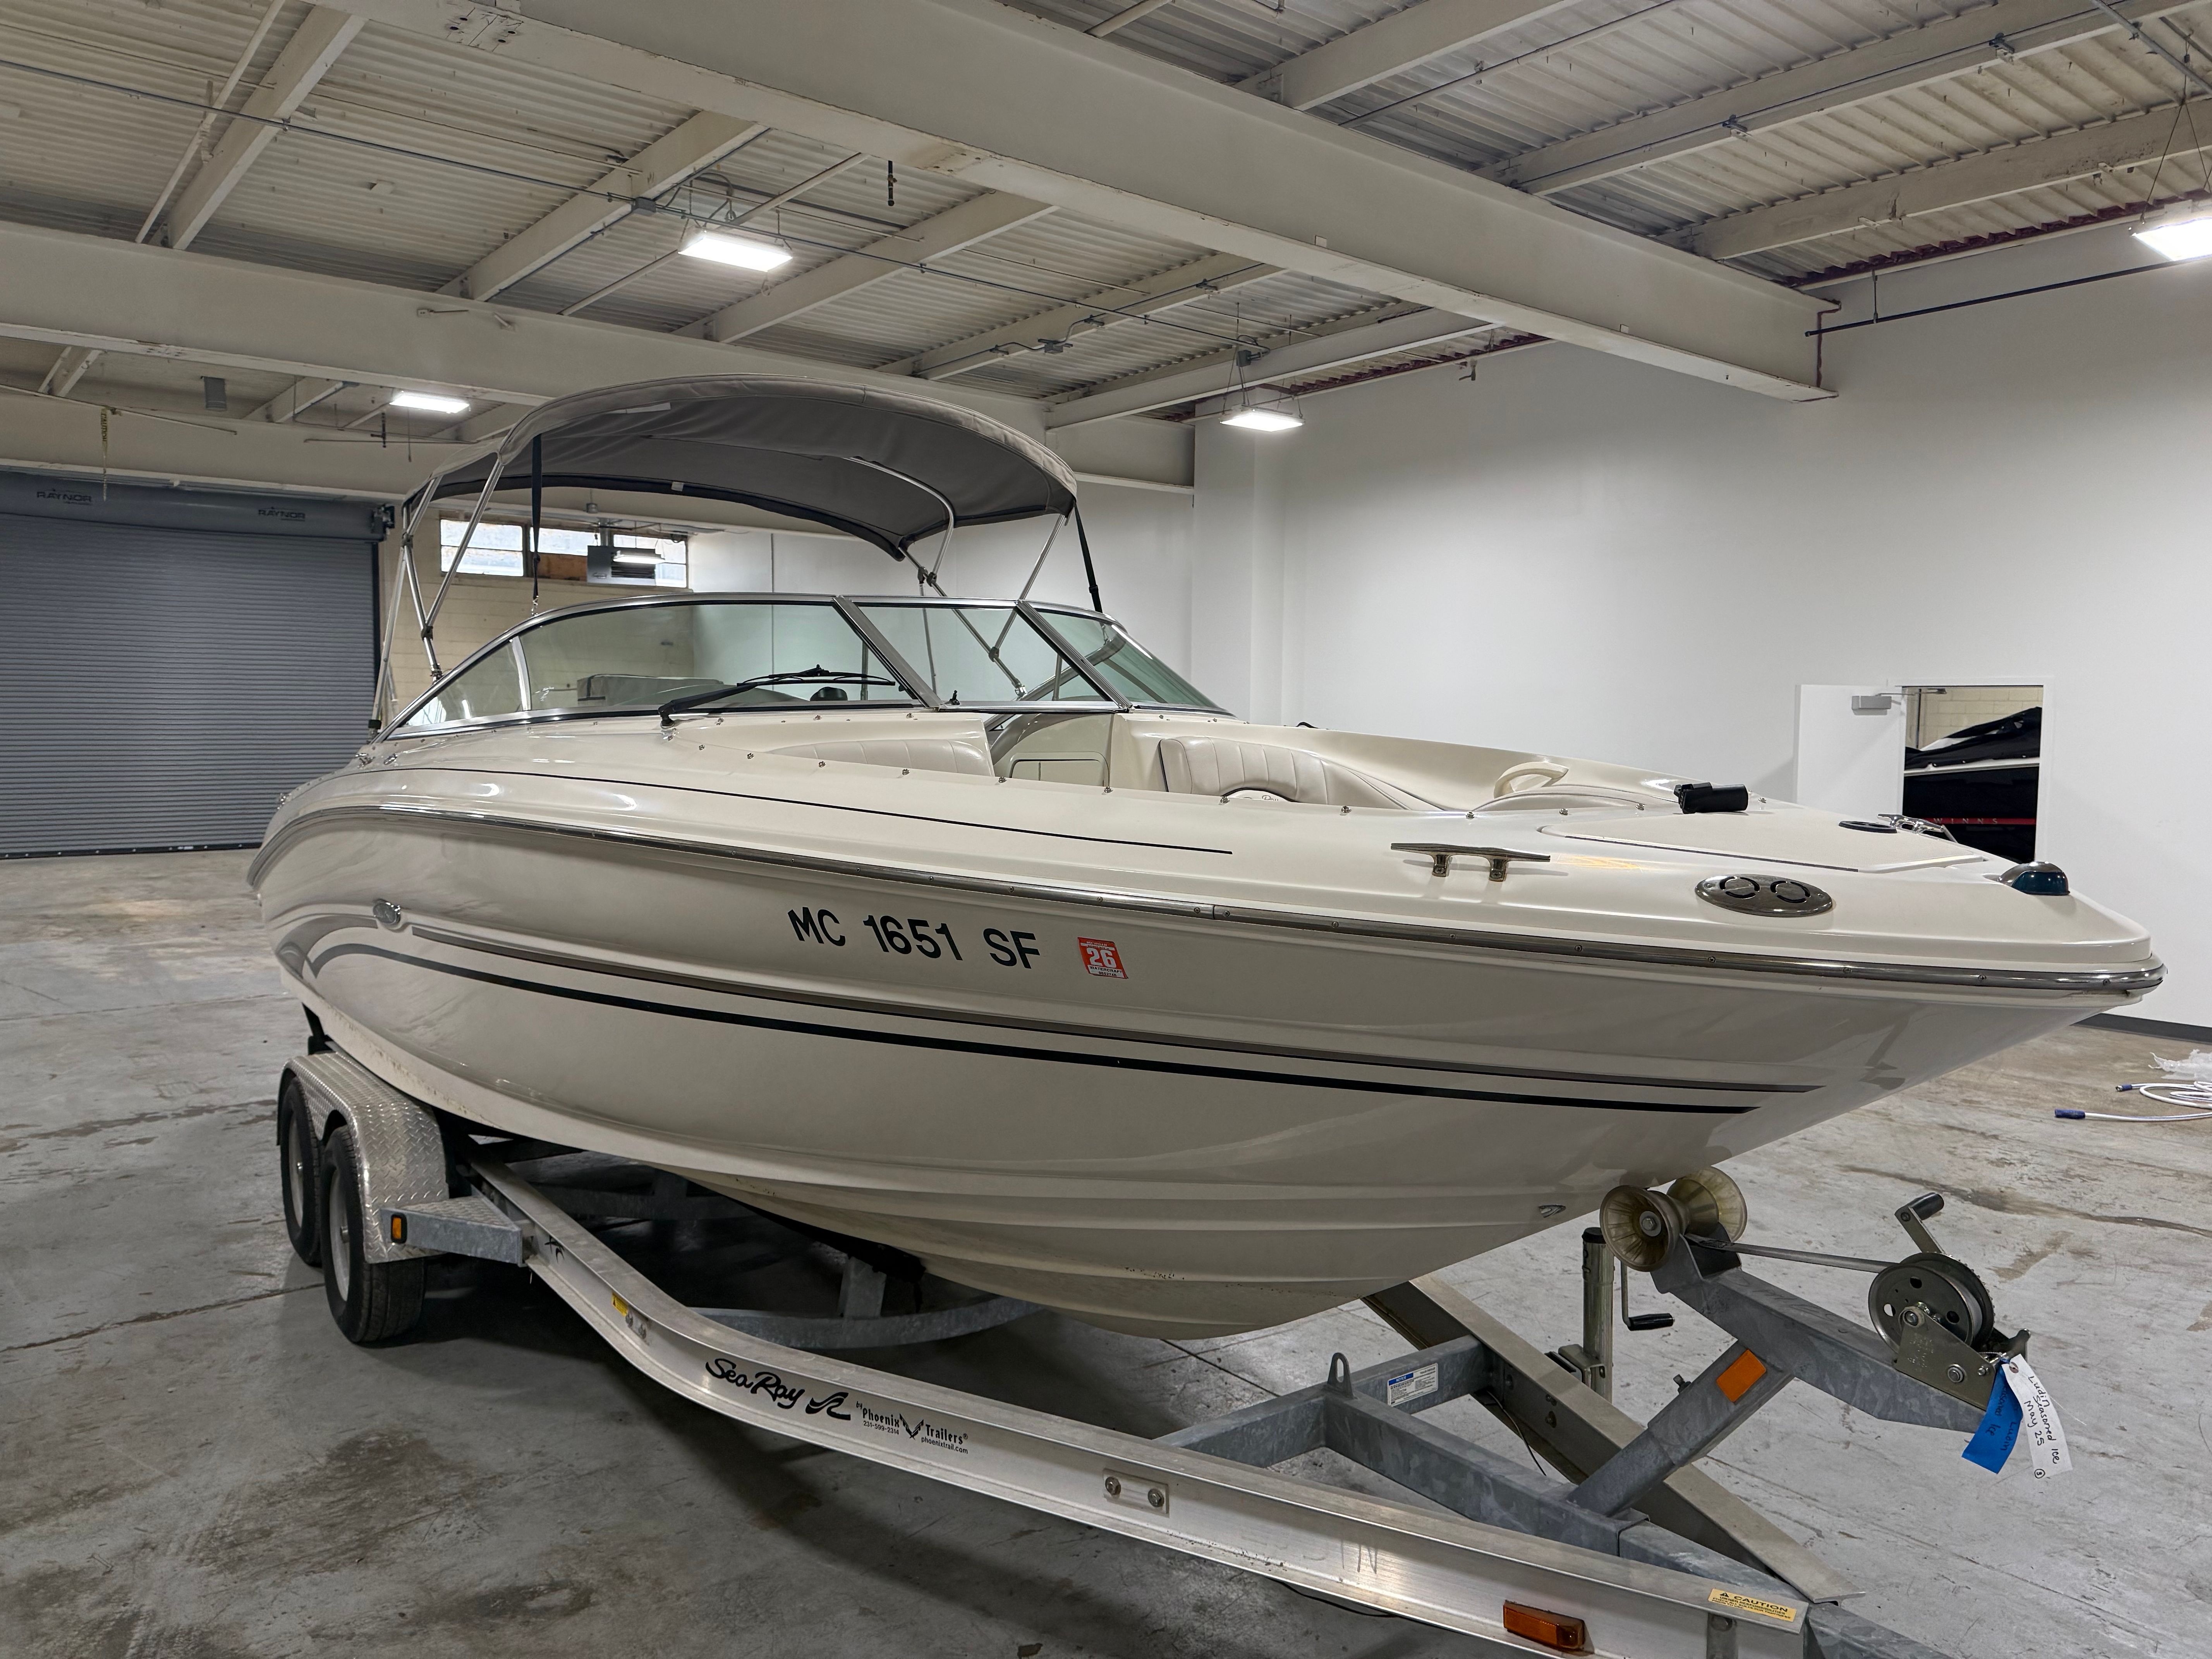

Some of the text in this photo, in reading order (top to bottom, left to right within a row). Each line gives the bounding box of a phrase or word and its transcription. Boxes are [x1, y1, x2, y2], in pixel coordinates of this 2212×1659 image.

[37, 491, 92, 502] RAYNOR
[258, 509, 305, 519] RAYNOR
[788, 907, 1040, 969] MC 1651 SF
[1086, 947, 1116, 969] 26
[856, 1401, 862, 1409] by
[862, 1408, 899, 1428] Phoenix
[2024, 1401, 2044, 1446] May 25
[922, 1436, 968, 1454] phoenixtrail.com
[1734, 1596, 1788, 1612] CAUTION
